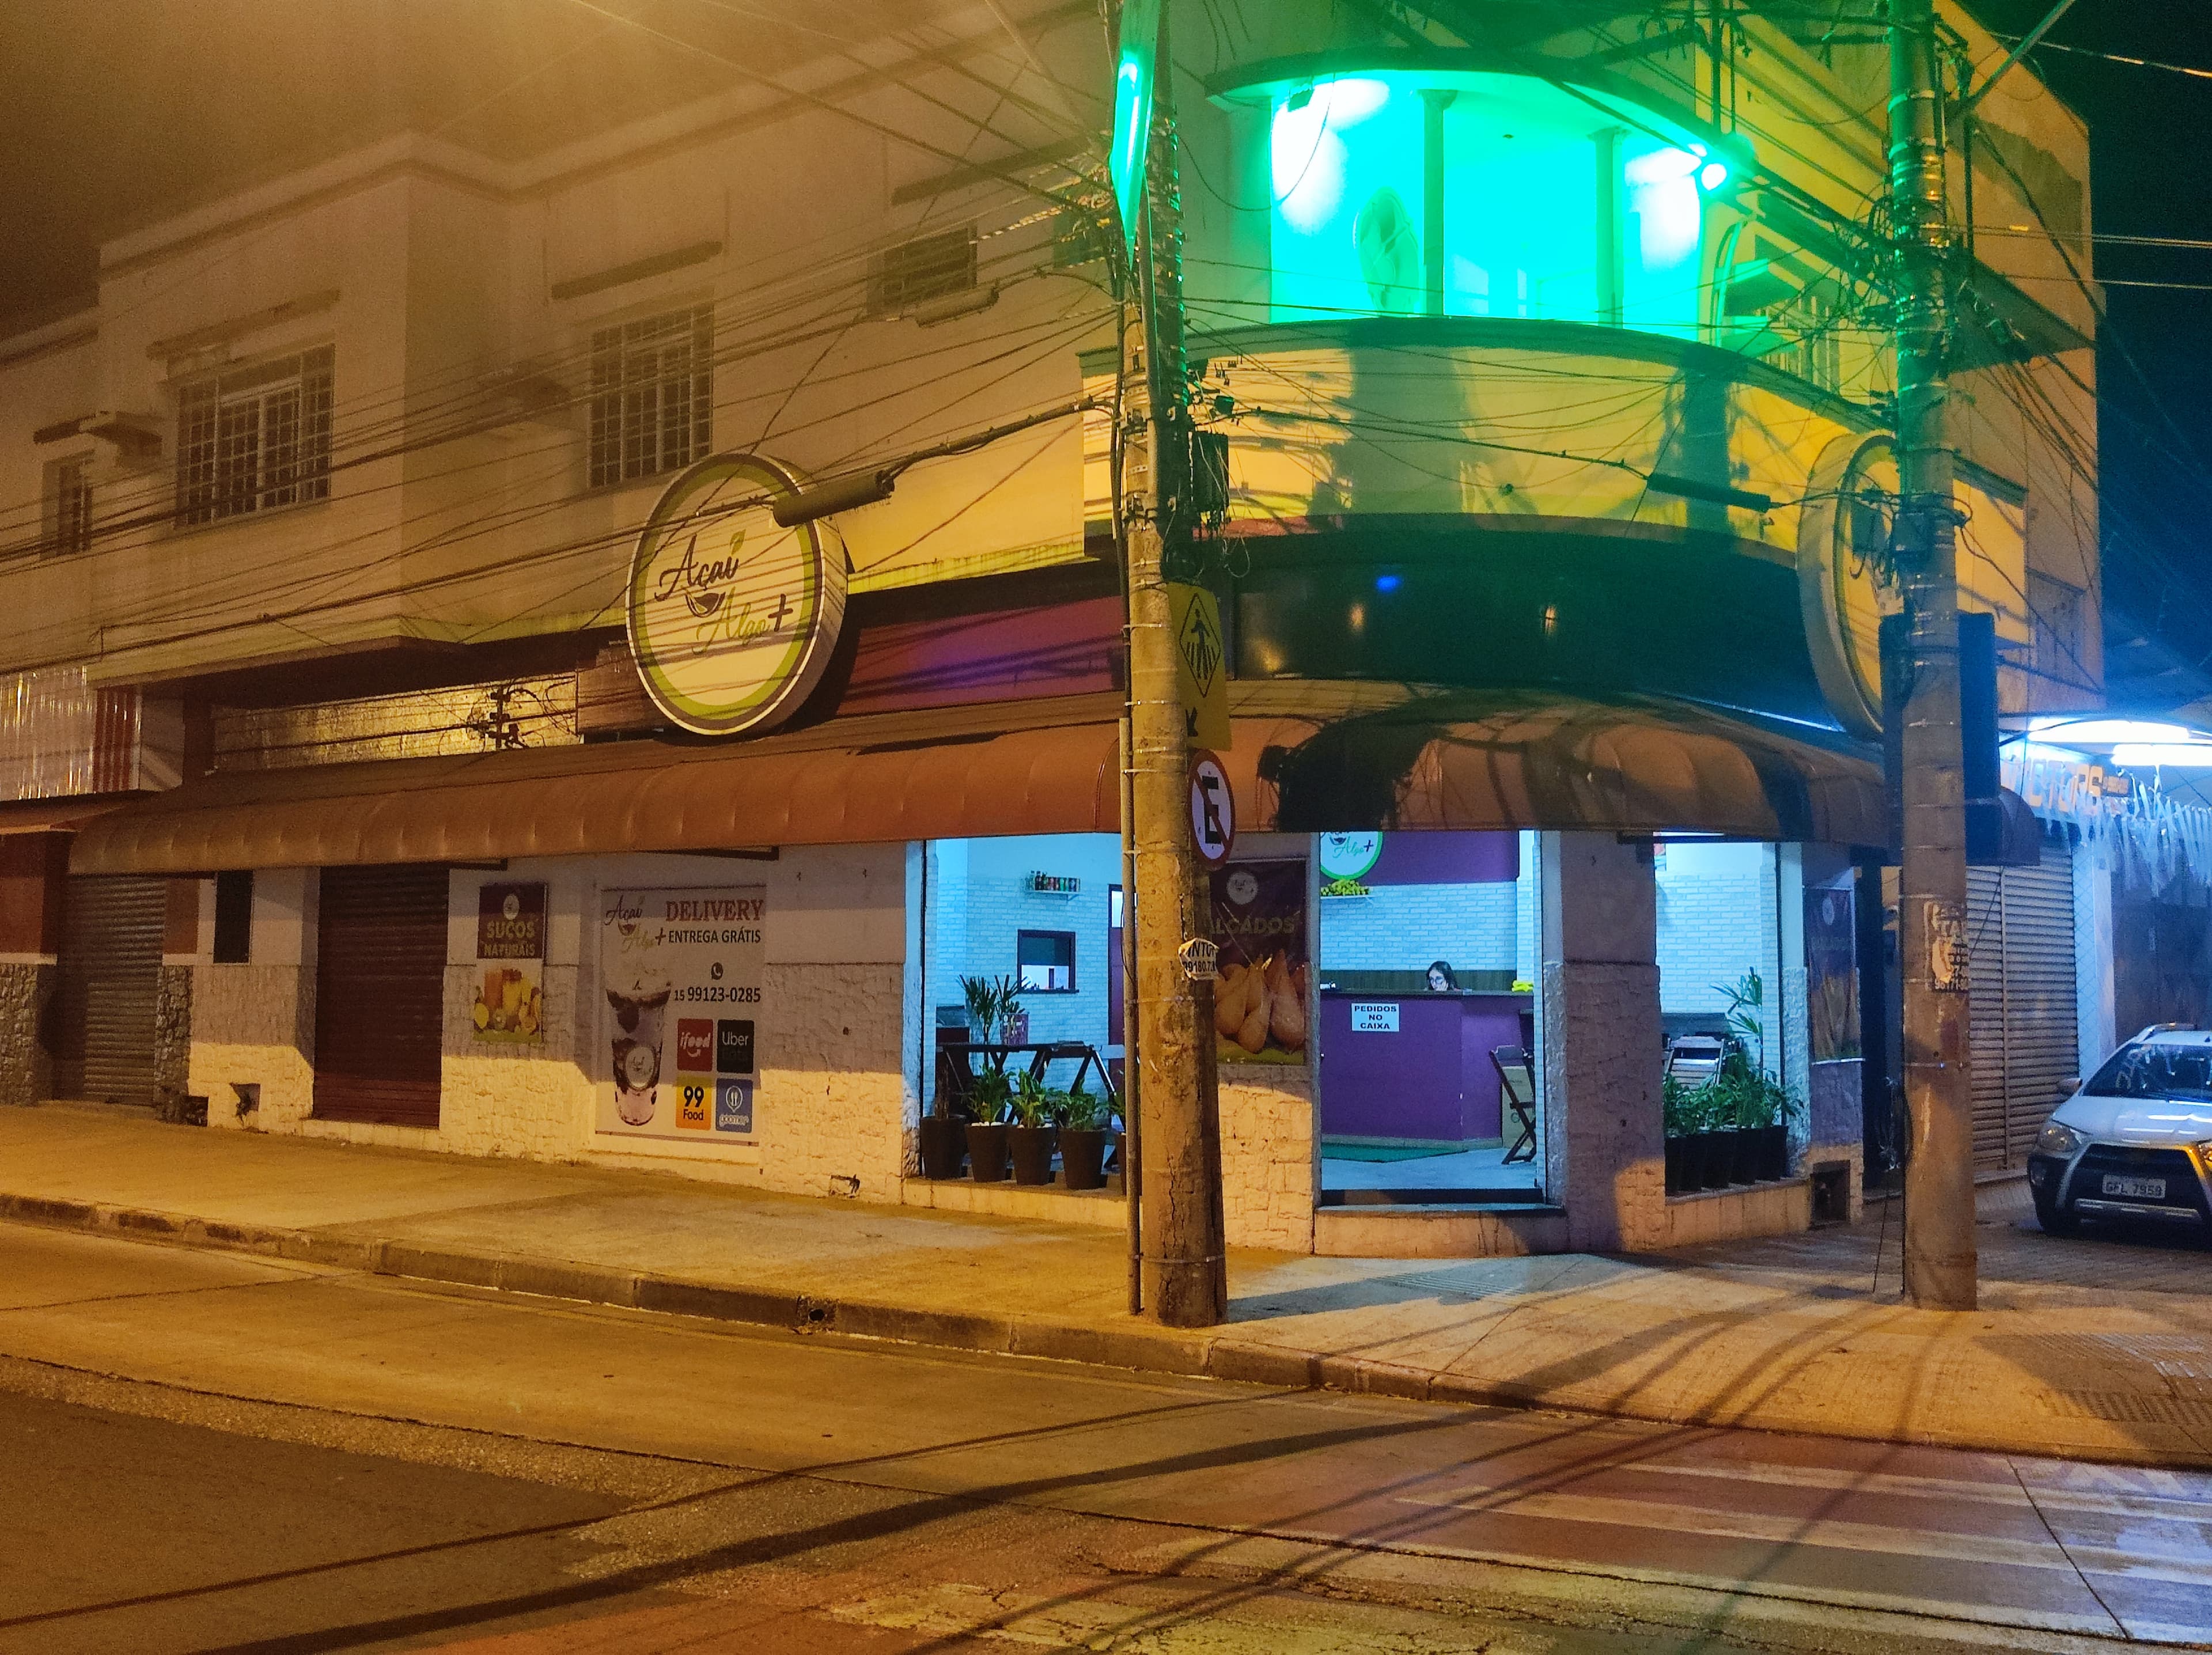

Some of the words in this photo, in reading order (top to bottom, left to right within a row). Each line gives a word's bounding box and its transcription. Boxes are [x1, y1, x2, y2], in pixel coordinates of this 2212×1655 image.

[665, 899, 764, 922] DELIVERY
[668, 930, 719, 943] ENTREGA
[721, 926, 761, 944] GRÁTIS
[674, 990, 685, 1001] 15
[687, 986, 761, 1003] 99123-0285
[722, 1031, 748, 1046] Uber
[684, 1086, 704, 1108] 99
[683, 1109, 704, 1121] Food
